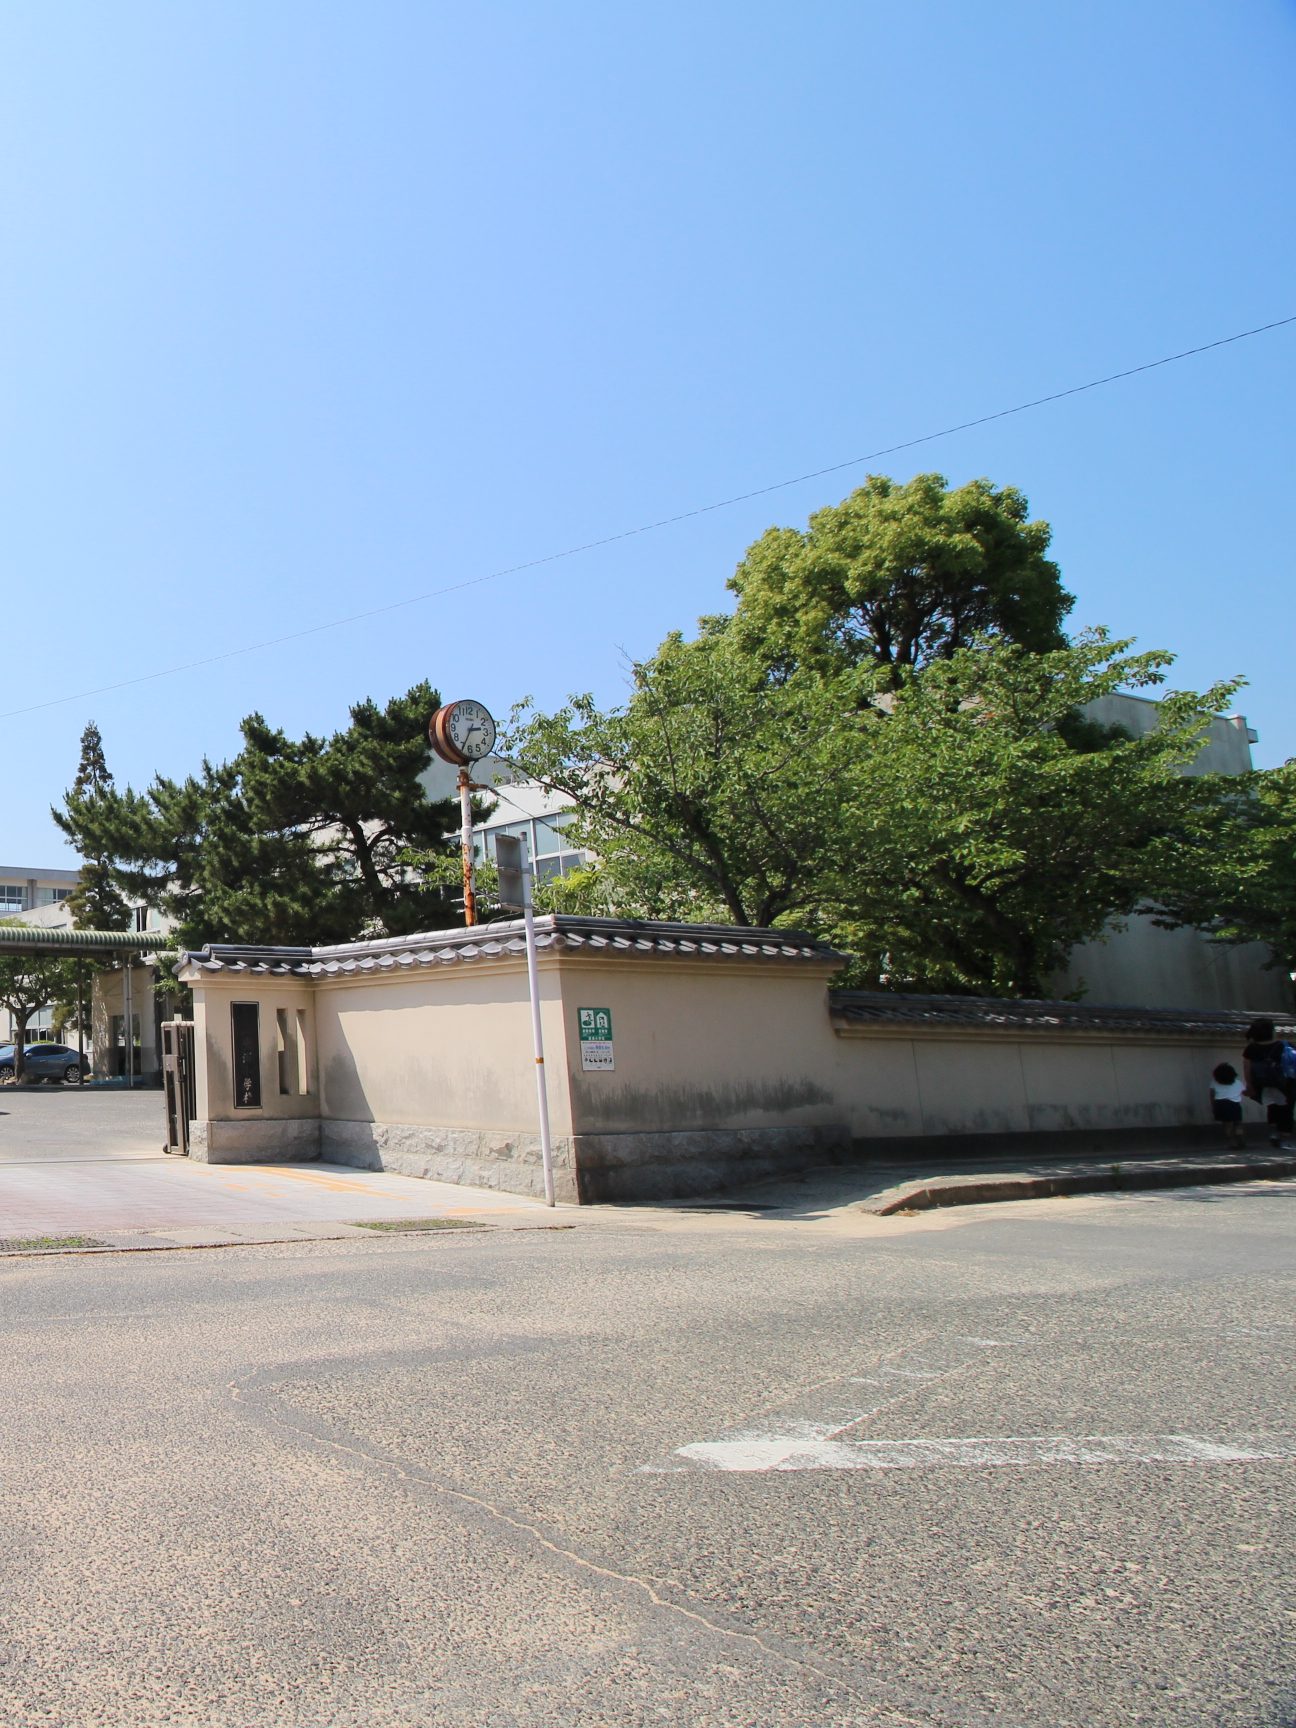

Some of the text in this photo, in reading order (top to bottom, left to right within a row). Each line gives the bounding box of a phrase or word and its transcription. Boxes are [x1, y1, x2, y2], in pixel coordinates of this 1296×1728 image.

[466, 706, 473, 715] 12
[451, 714, 459, 722] 10
[480, 717, 486, 726] 2
[450, 723, 456, 732] 9
[453, 732, 460, 742] 8
[483, 728, 489, 737] 3
[467, 745, 473, 753] 6
[475, 744, 481, 752] 5
